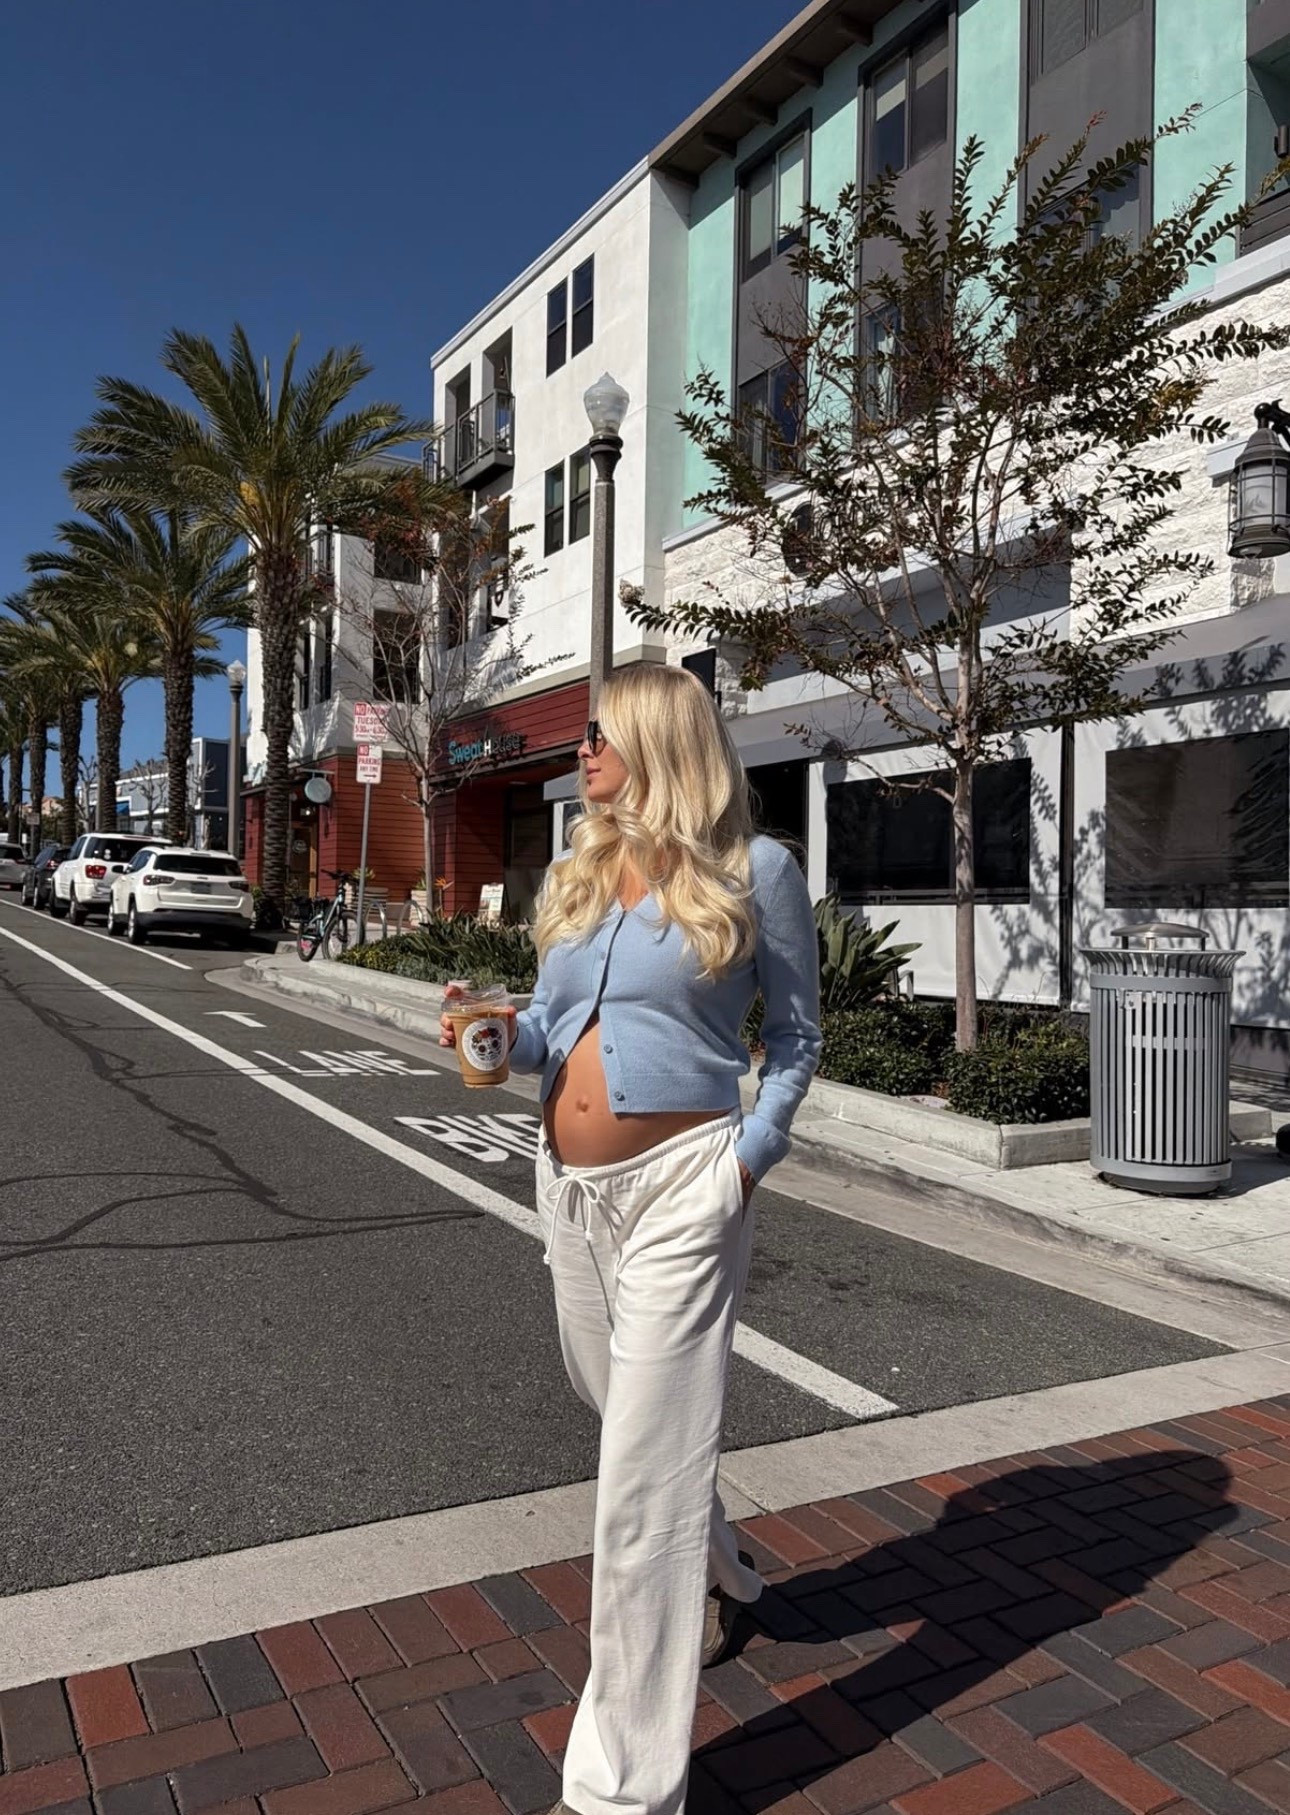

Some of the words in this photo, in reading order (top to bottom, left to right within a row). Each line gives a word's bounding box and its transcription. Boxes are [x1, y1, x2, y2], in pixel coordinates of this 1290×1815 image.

[358, 757, 380, 765] PARKING
[252, 1050, 442, 1077] LANE
[393, 1113, 541, 1163] BIKE
